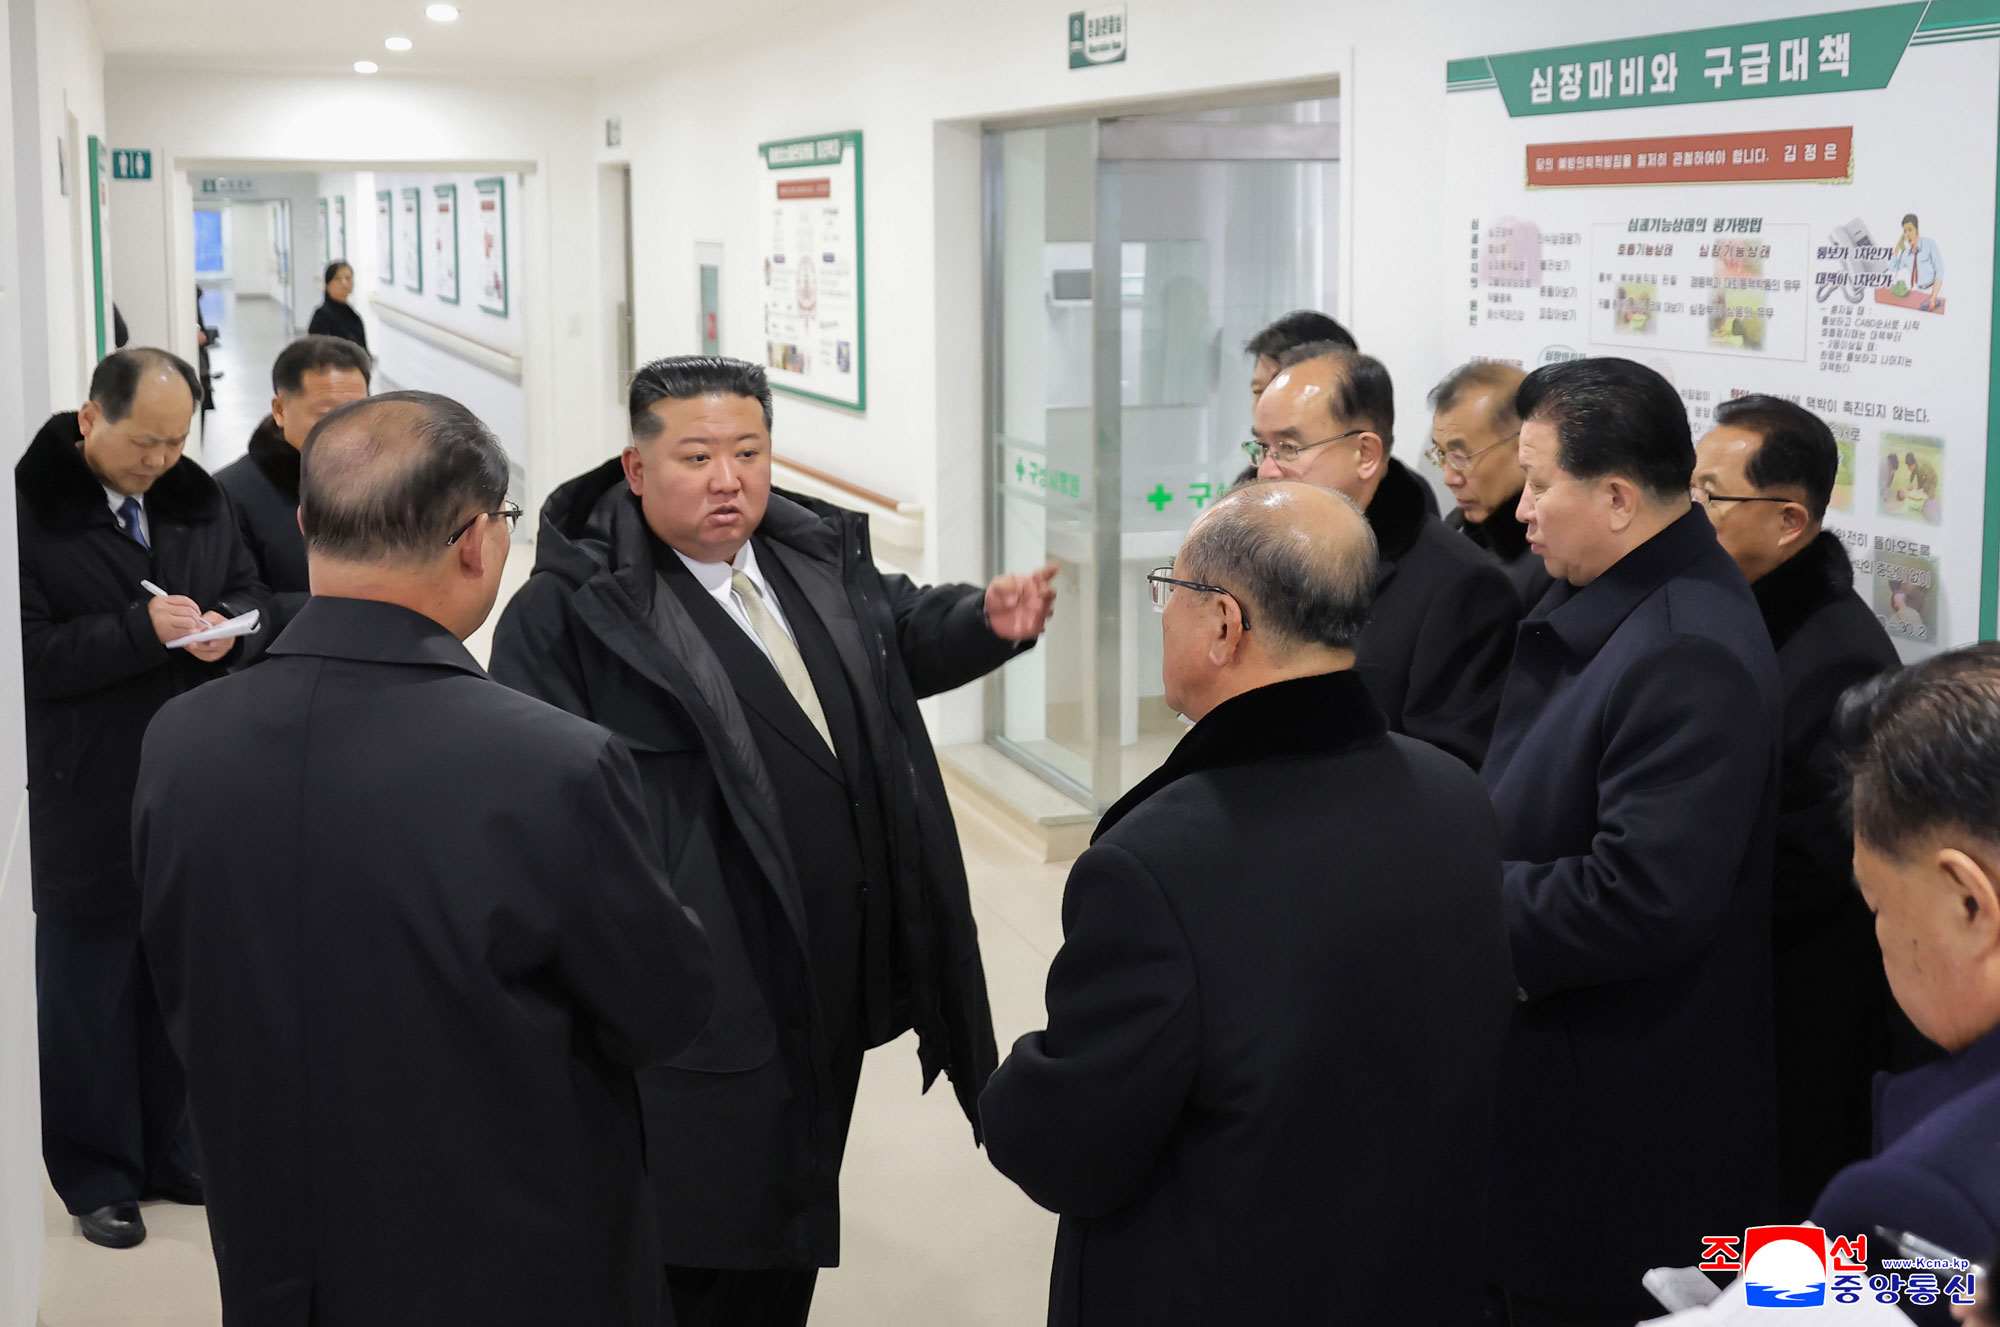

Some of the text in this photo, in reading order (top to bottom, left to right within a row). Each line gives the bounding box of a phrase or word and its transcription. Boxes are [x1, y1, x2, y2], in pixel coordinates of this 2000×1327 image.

[1529, 32, 1851, 104] 심장마비와 구급대책
[1536, 156, 1554, 172] 당의
[1637, 152, 1667, 168] 철저히
[1672, 149, 1727, 167] 관철하여야
[1732, 148, 1770, 164] 합니다.
[1712, 217, 1763, 234] 평가방법
[1618, 243, 1674, 257] 호흡기능상태
[1699, 244, 1771, 258] 심장기능상태
[1817, 246, 1894, 261] 통보가 1차인가
[1784, 279, 1801, 292] 유무
[1815, 272, 1893, 288] 대책이 1차인가
[1756, 307, 1774, 320] 유무
[1904, 320, 1920, 331] 시작
[1806, 396, 1837, 414] 맥박이
[1842, 400, 1886, 418] 촉진되지
[1892, 405, 1930, 424] 않는다.
[1874, 536, 1931, 558] 돌아오도록
